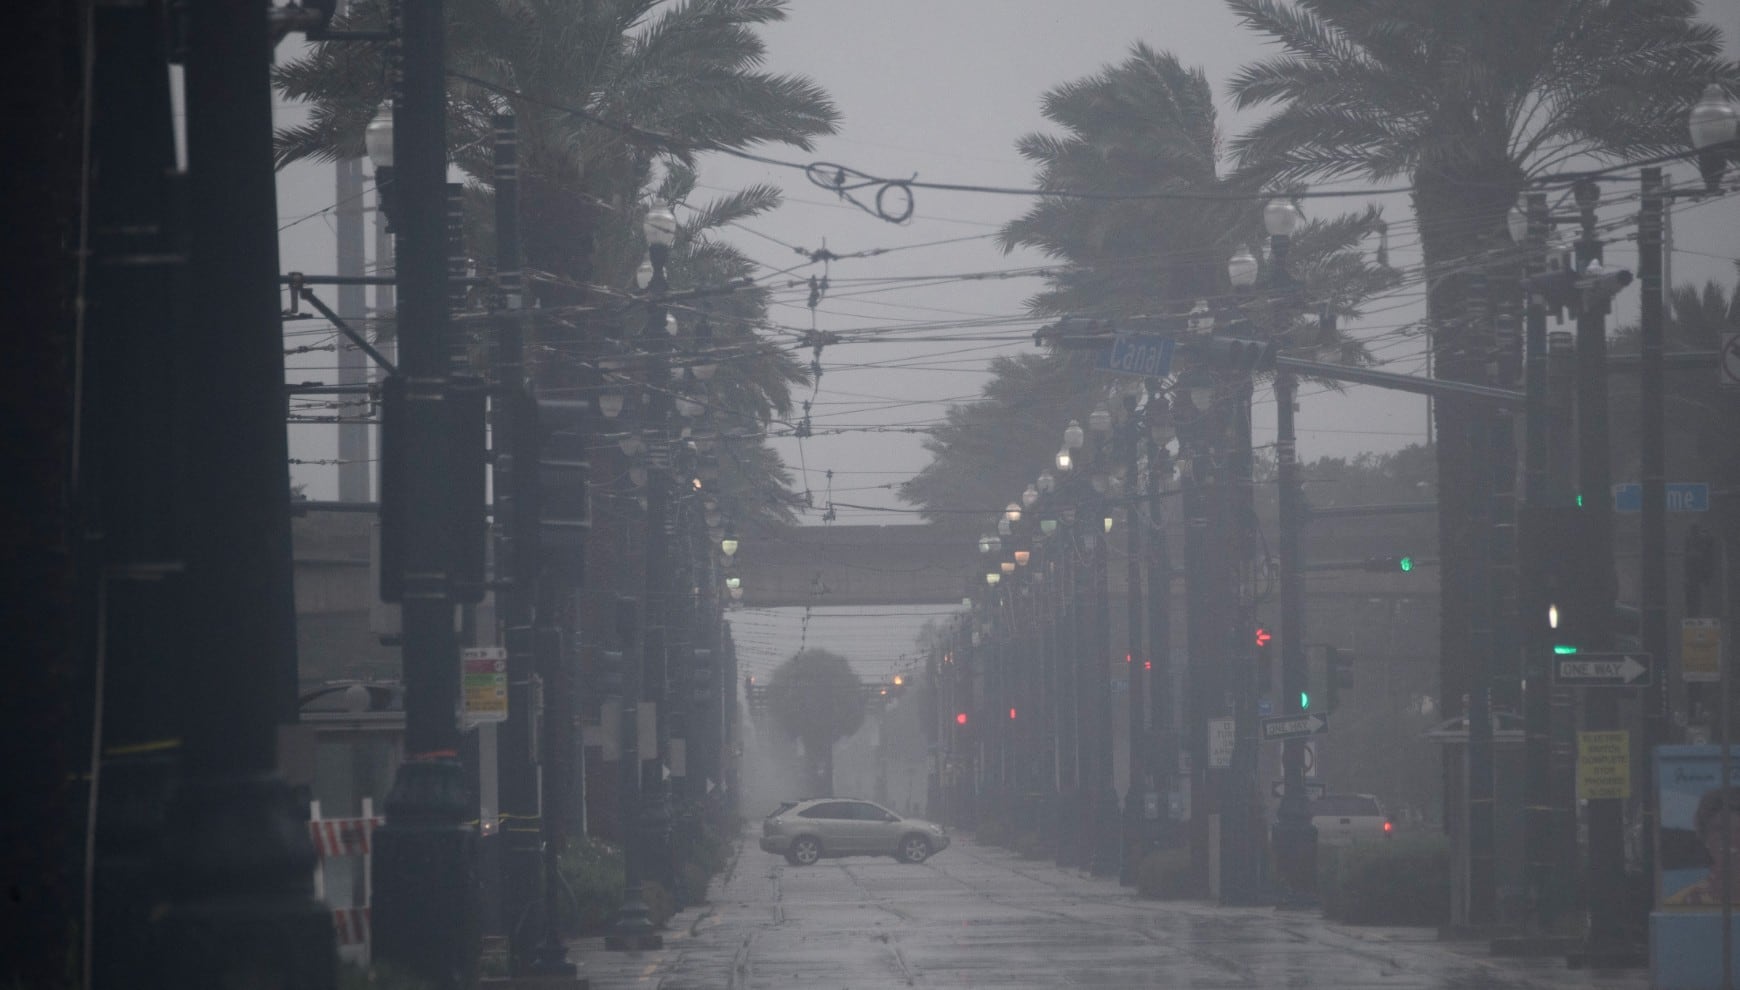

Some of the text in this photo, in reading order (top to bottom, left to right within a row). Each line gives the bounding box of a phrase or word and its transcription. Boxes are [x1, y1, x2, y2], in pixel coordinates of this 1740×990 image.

[1110, 335, 1164, 375] Canal
[1666, 489, 1694, 509] me
[1563, 663, 1621, 675] ONE WAY
[1269, 720, 1308, 734] ONE WAY
